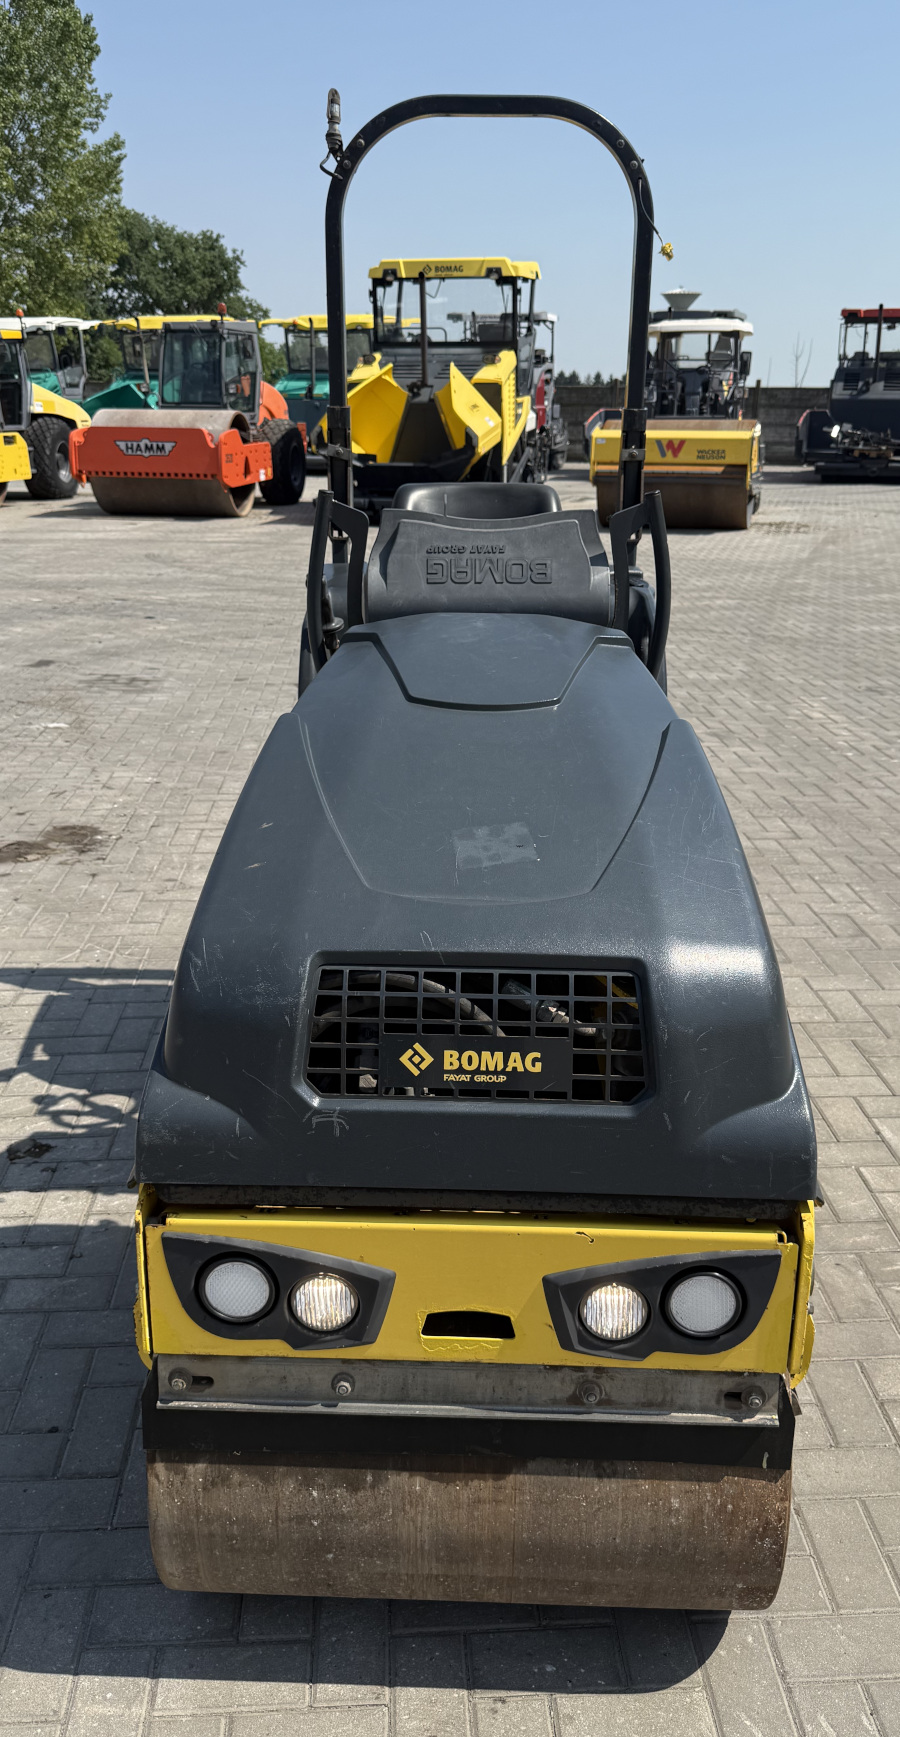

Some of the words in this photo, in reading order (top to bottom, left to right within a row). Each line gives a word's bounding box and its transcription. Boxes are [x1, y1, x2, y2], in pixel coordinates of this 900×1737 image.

[434, 265, 464, 273] BOMAG
[125, 443, 167, 455] HAMM
[426, 545, 467, 554] GROUP
[469, 545, 506, 554] FAYAT
[426, 558, 552, 585] BOMAG
[443, 1049, 542, 1073] BOMAG
[443, 1074, 472, 1082] FAYAT
[473, 1074, 507, 1083] GROUP
